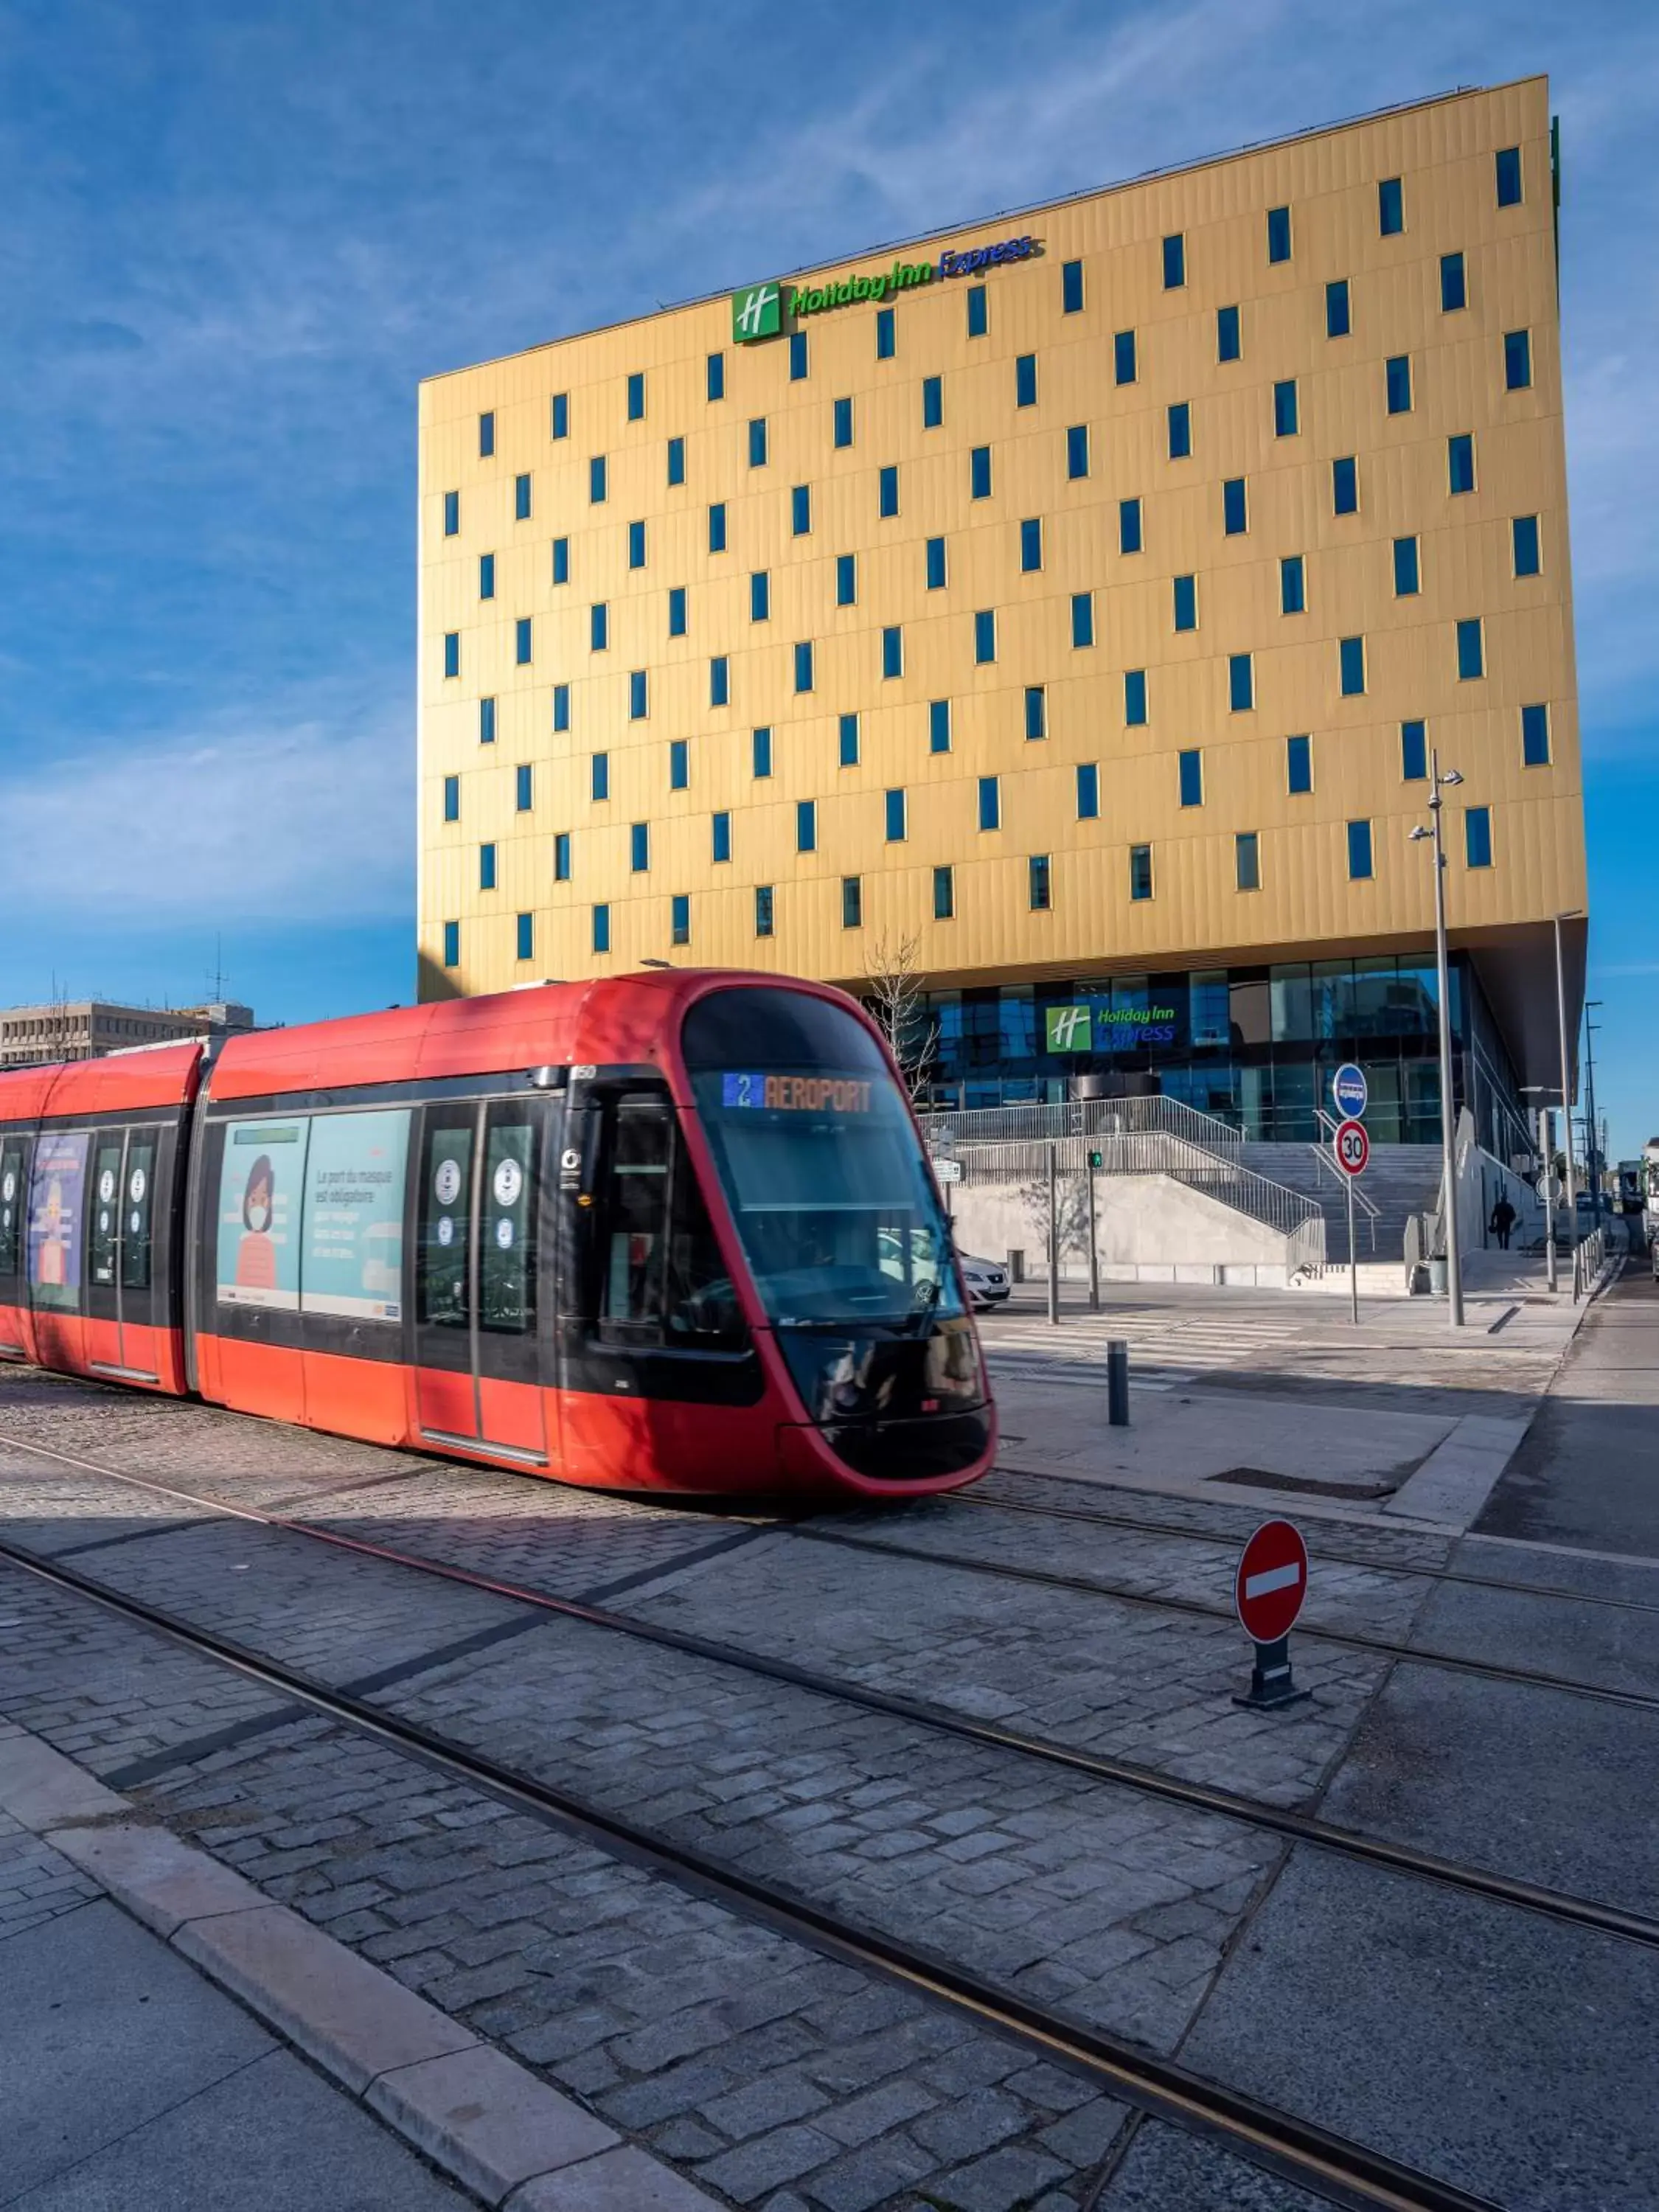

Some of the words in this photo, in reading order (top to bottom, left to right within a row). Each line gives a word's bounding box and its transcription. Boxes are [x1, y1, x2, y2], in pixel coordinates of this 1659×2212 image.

[789, 274, 887, 316] Holiday
[890, 260, 932, 290] Inn
[939, 235, 1032, 277] Express
[1098, 1007, 1151, 1024] Holiday
[1152, 1005, 1175, 1020] Inn
[738, 1074, 751, 1107] 2
[764, 1075, 872, 1112] AEROPORT
[1343, 1135, 1363, 1159] 30
